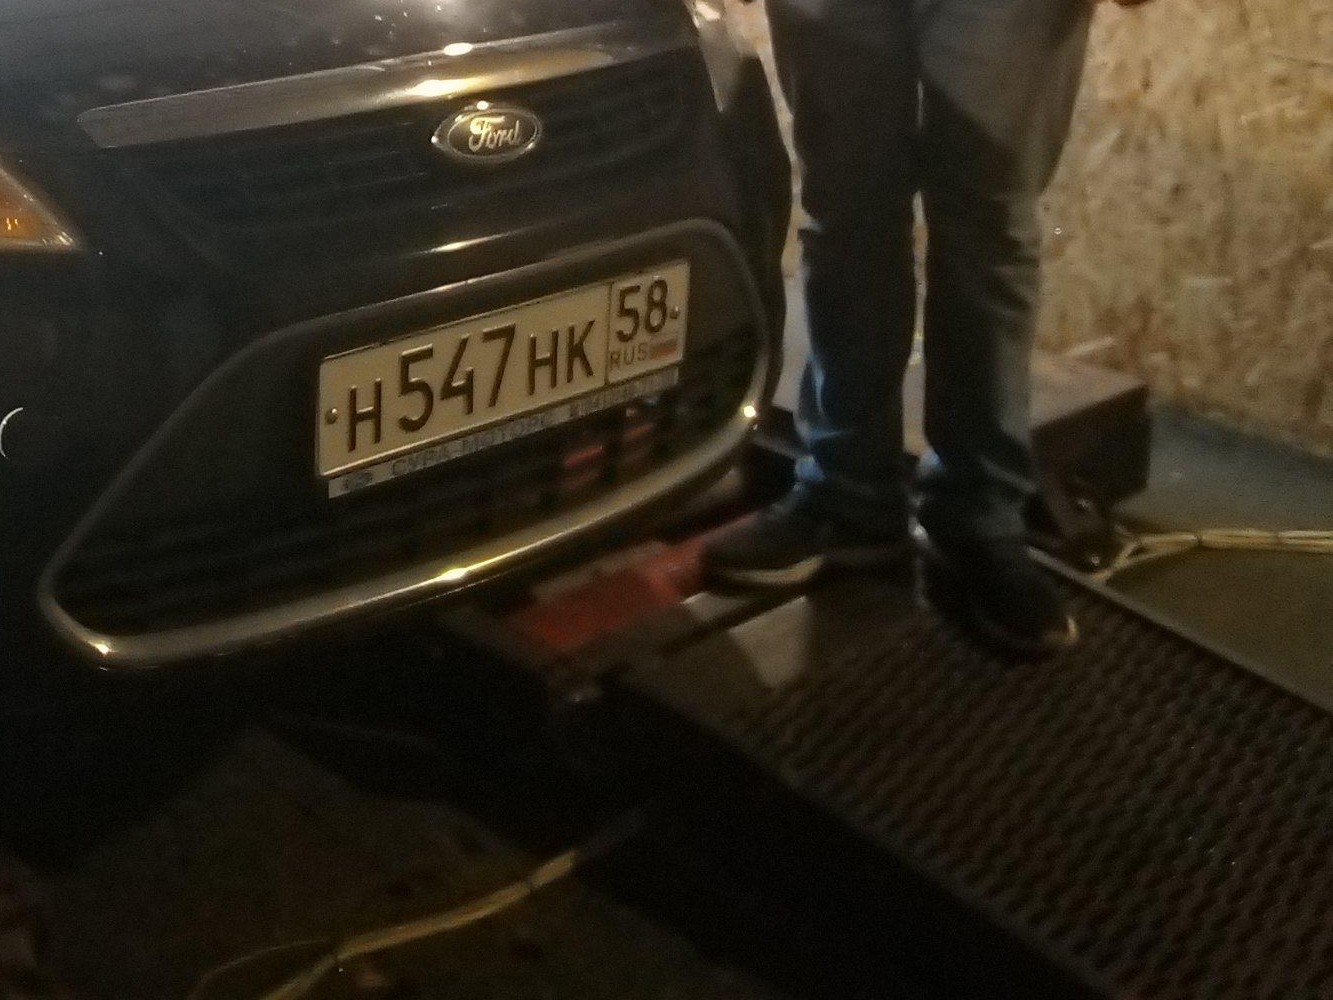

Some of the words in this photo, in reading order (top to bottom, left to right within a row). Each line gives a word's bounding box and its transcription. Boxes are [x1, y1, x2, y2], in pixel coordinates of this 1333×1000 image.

[468, 115, 522, 152] Ford
[347, 320, 595, 452] Н547НК
[615, 278, 669, 343] 58
[609, 340, 648, 371] RUS
